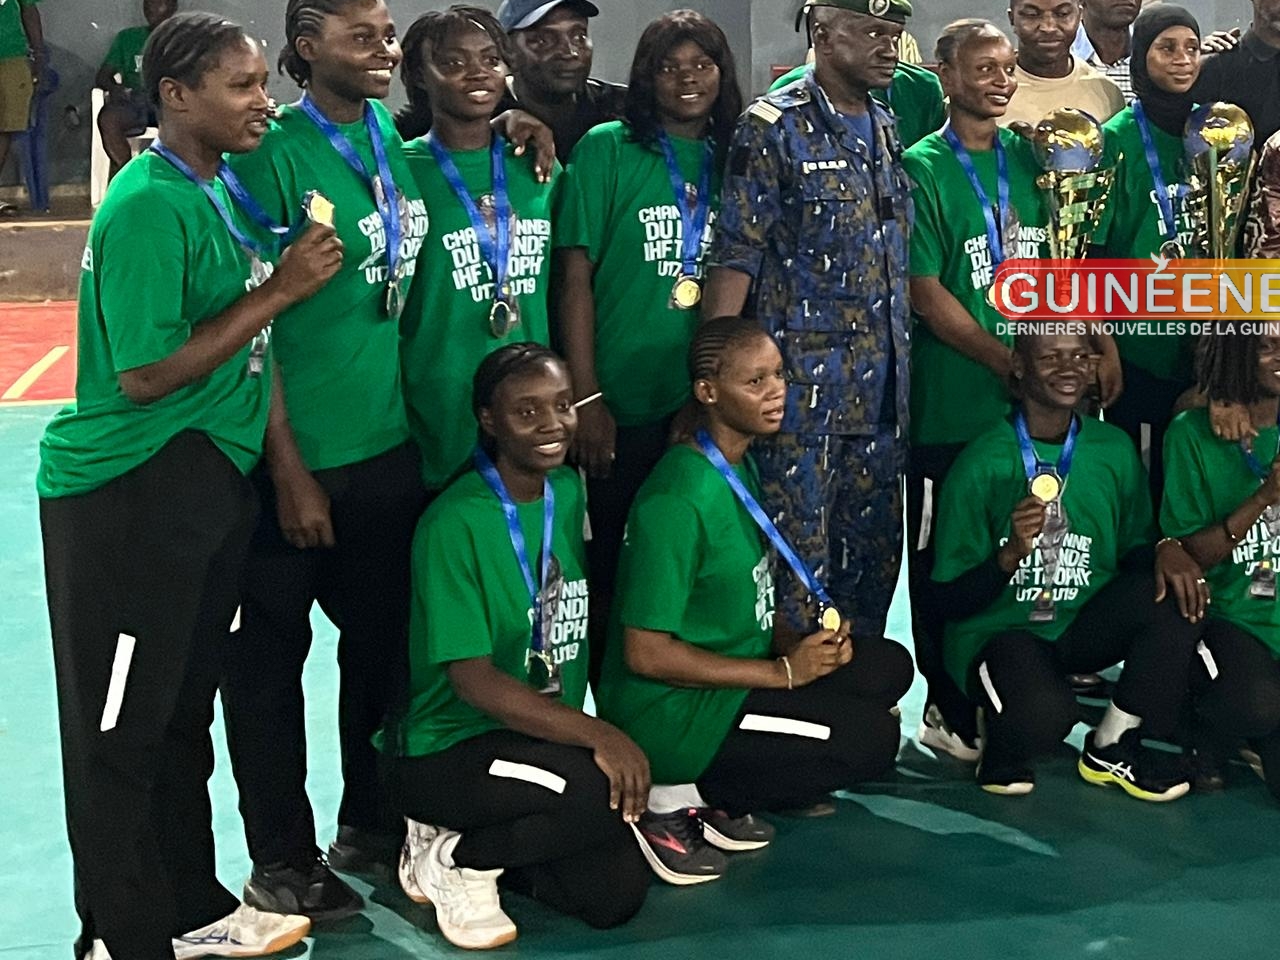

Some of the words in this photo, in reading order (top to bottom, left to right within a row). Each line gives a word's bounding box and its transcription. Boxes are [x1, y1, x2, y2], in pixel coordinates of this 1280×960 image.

[645, 220, 673, 241] DU
[452, 243, 480, 269] DU
[644, 239, 673, 262] IHF
[971, 249, 992, 271] DU
[452, 263, 481, 290] IHF
[509, 278, 536, 296] U19
[971, 267, 993, 290] IHF
[1232, 543, 1259, 564] IHF
[1016, 587, 1043, 602] U17
[1052, 587, 1079, 601] U19
[552, 643, 579, 664] U19
